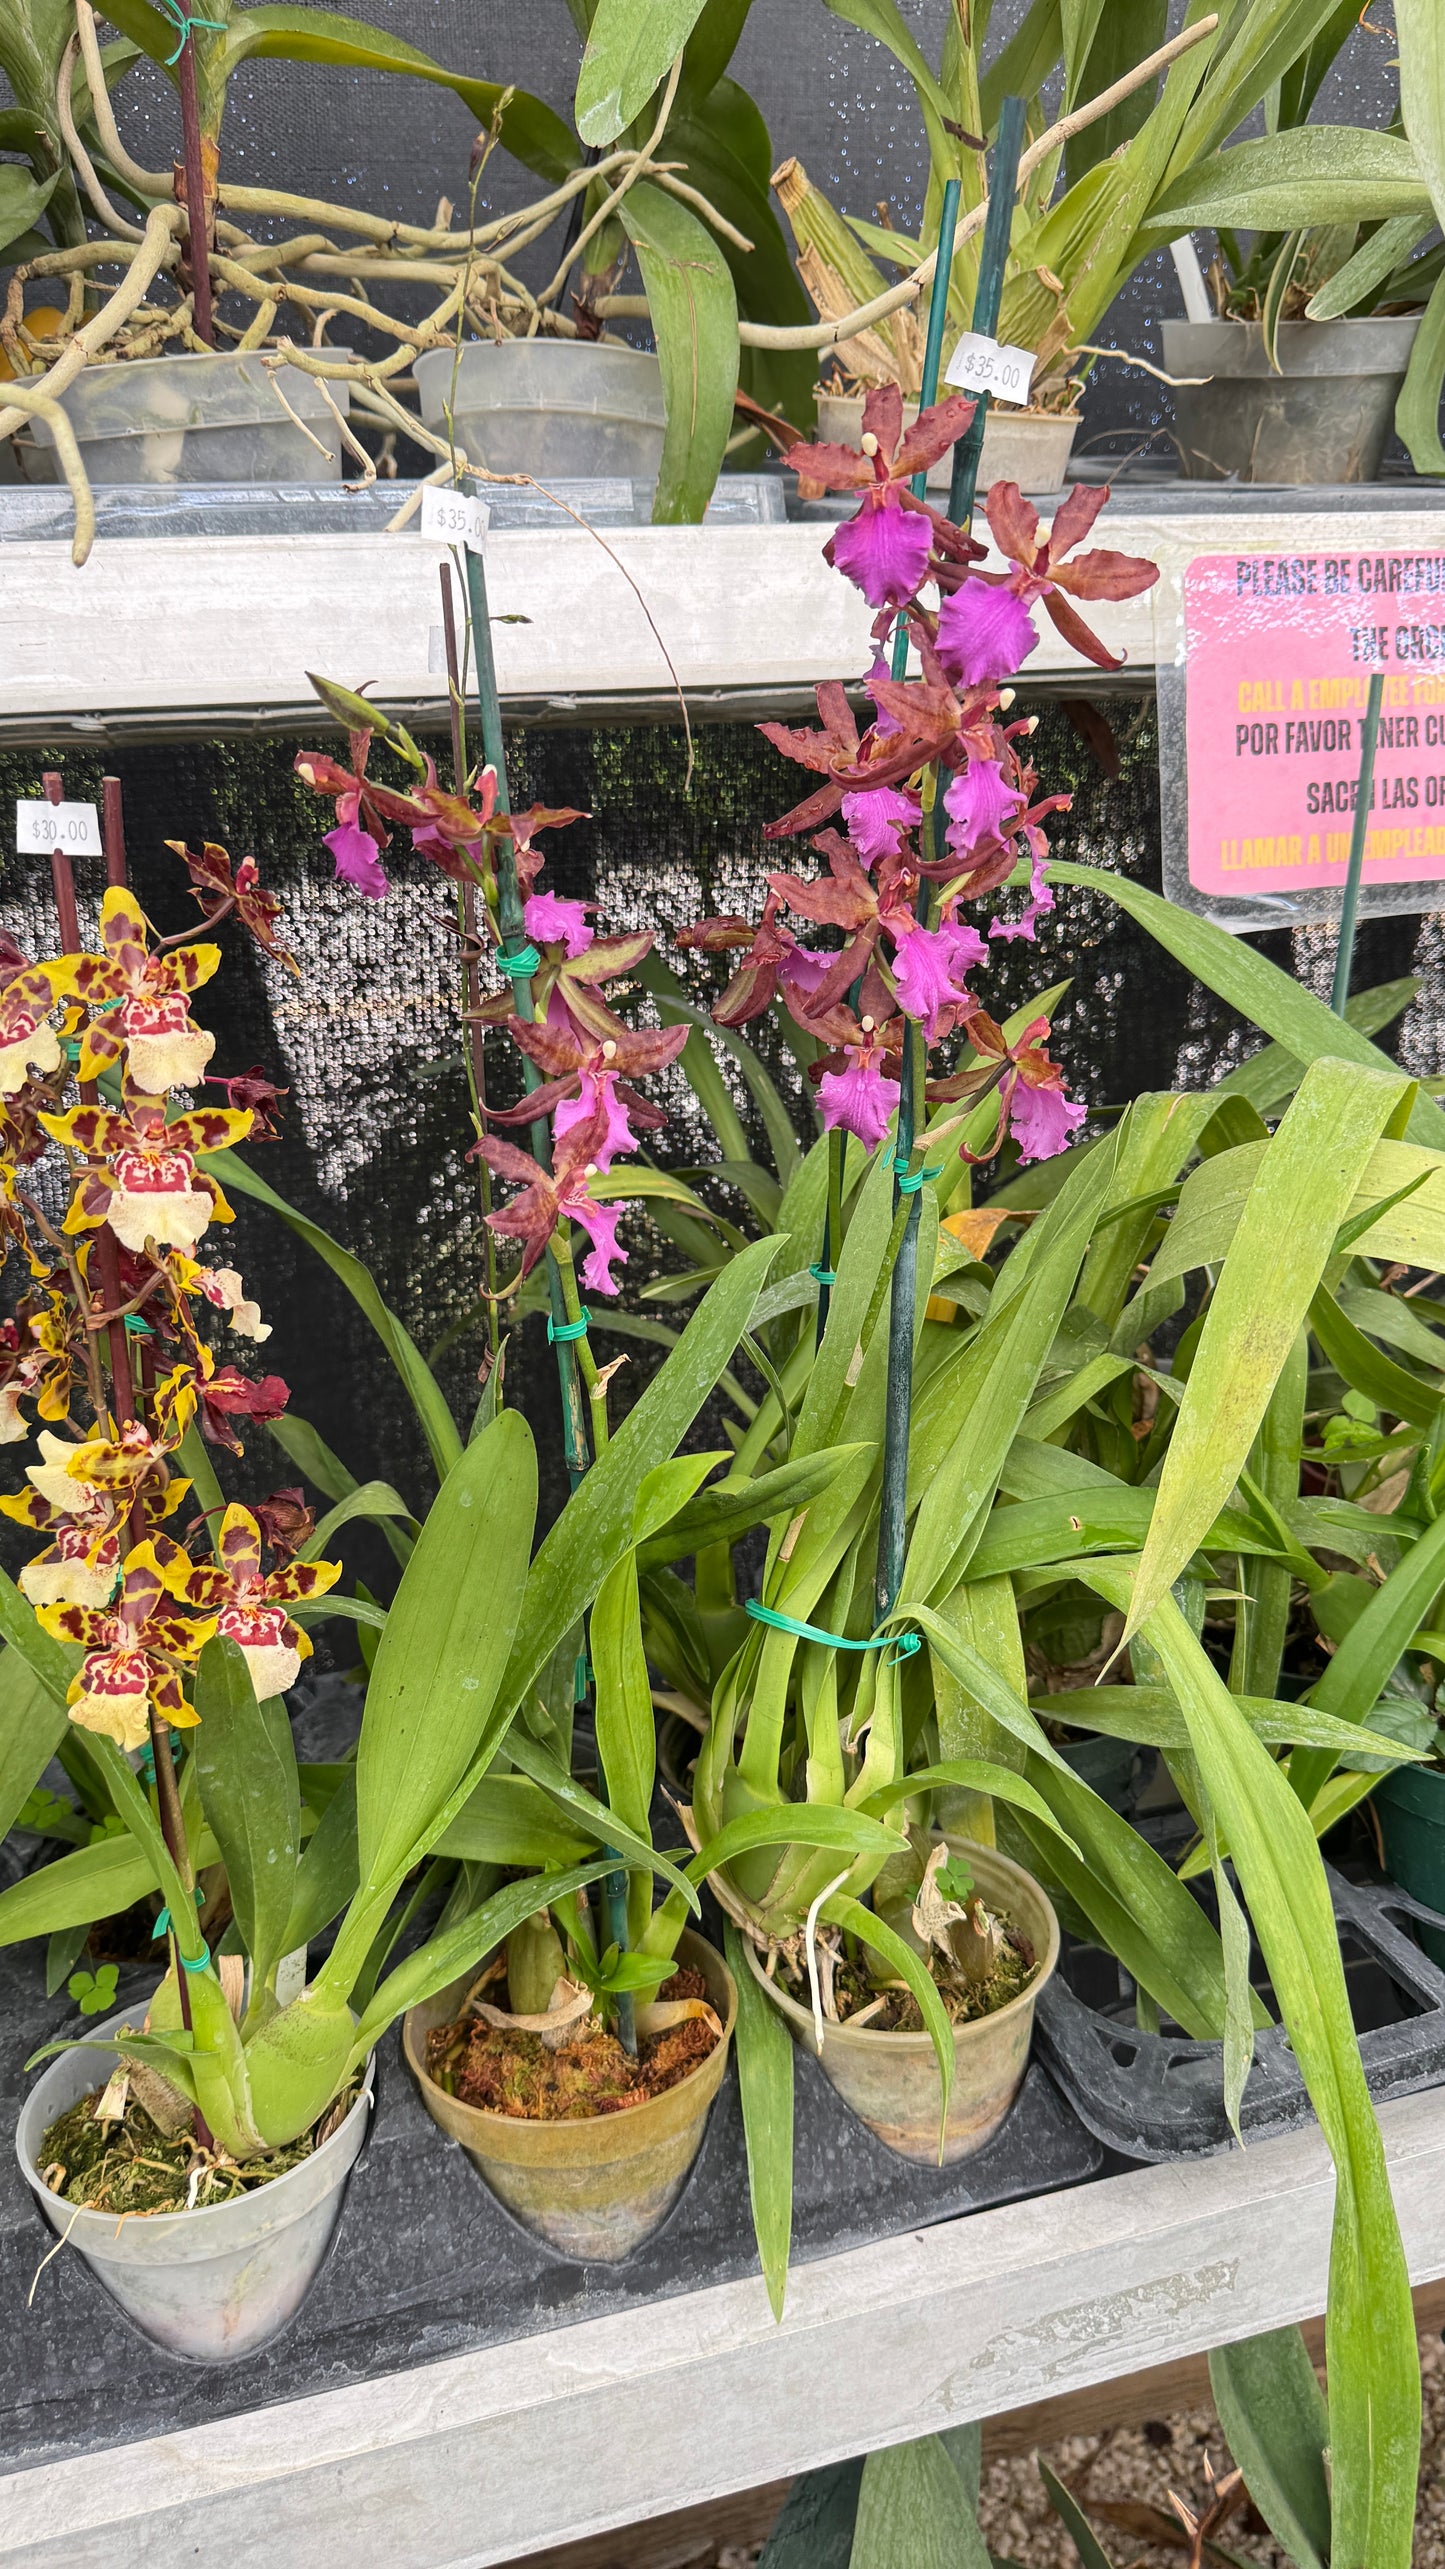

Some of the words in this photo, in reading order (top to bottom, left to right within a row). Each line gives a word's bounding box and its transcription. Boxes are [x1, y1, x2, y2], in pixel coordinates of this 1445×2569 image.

[965, 352, 1020, 388] $35.00
[1236, 559, 1318, 596] PLEASE
[1324, 559, 1351, 594] BE
[1350, 626, 1388, 661] THE
[1239, 681, 1285, 713] CALL
[1291, 679, 1304, 710] A
[1236, 723, 1278, 756] POR
[1285, 719, 1351, 754] FAVOR
[1357, 716, 1419, 751] TNER
[1382, 777, 1419, 809] LAS
[32, 820, 88, 841] $30.00
[1221, 835, 1301, 870] LLAMAR
[1307, 834, 1320, 865] A
